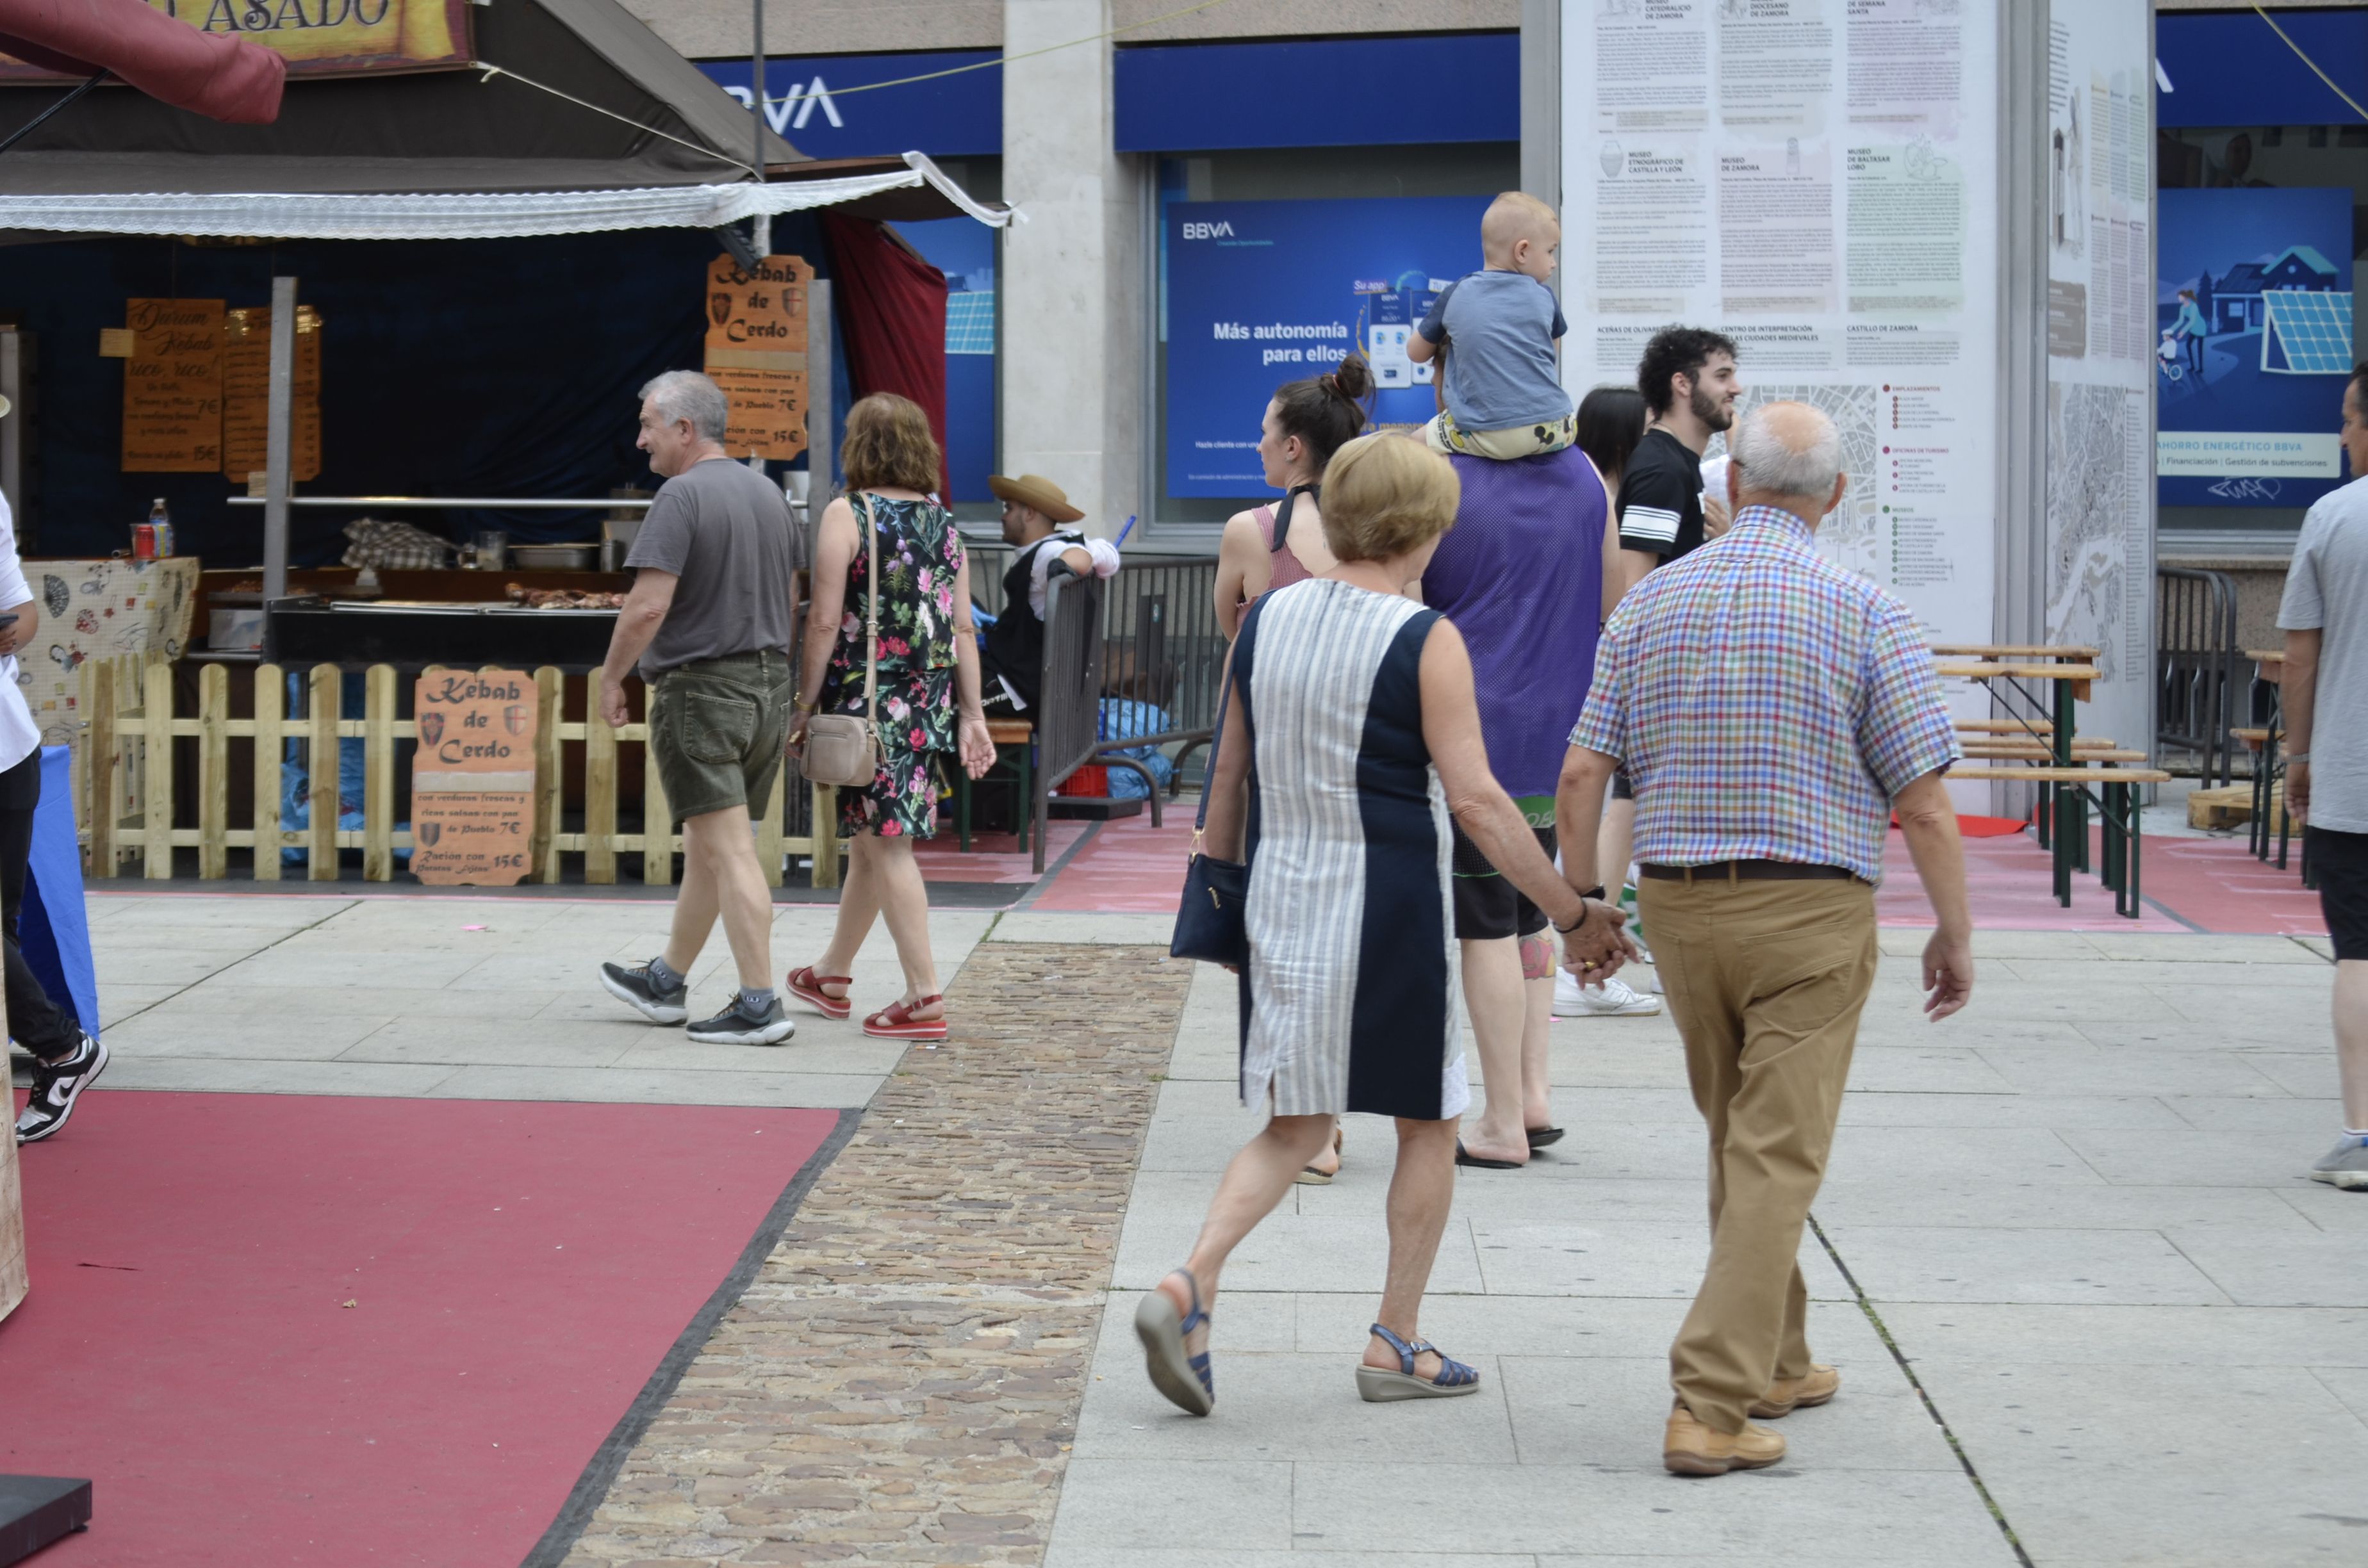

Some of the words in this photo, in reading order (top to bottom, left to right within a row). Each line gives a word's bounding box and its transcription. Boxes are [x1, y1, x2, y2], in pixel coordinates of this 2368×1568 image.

[1183, 221, 1235, 240] BBVA
[1354, 281, 1367, 290] Su
[1367, 282, 1385, 291] app
[748, 292, 769, 309] de
[727, 318, 789, 343] Cerdo
[1213, 322, 1249, 339] Más
[1253, 321, 1347, 338] autonomía
[1263, 348, 1302, 366] para
[1306, 345, 1348, 361] ellos
[778, 398, 797, 411] 7€
[773, 430, 800, 443] 15€
[2157, 441, 2200, 450] AHORRO
[2203, 441, 2271, 451] ENERGÉTICO
[2275, 443, 2302, 451] BBVA
[2166, 457, 2218, 466] Financiación
[2225, 457, 2257, 466] Gestión
[2271, 459, 2327, 468] subvenciones
[425, 676, 520, 705] Kebab
[463, 710, 489, 728] de
[439, 739, 511, 764] Cerdo
[437, 793, 477, 801] verduras
[481, 793, 514, 803] frescas
[449, 808, 480, 817] salsas
[502, 810, 519, 820] pan
[499, 821, 521, 835] 7€
[419, 850, 462, 863] Ración
[466, 853, 485, 861] con
[493, 853, 524, 868] 15€
